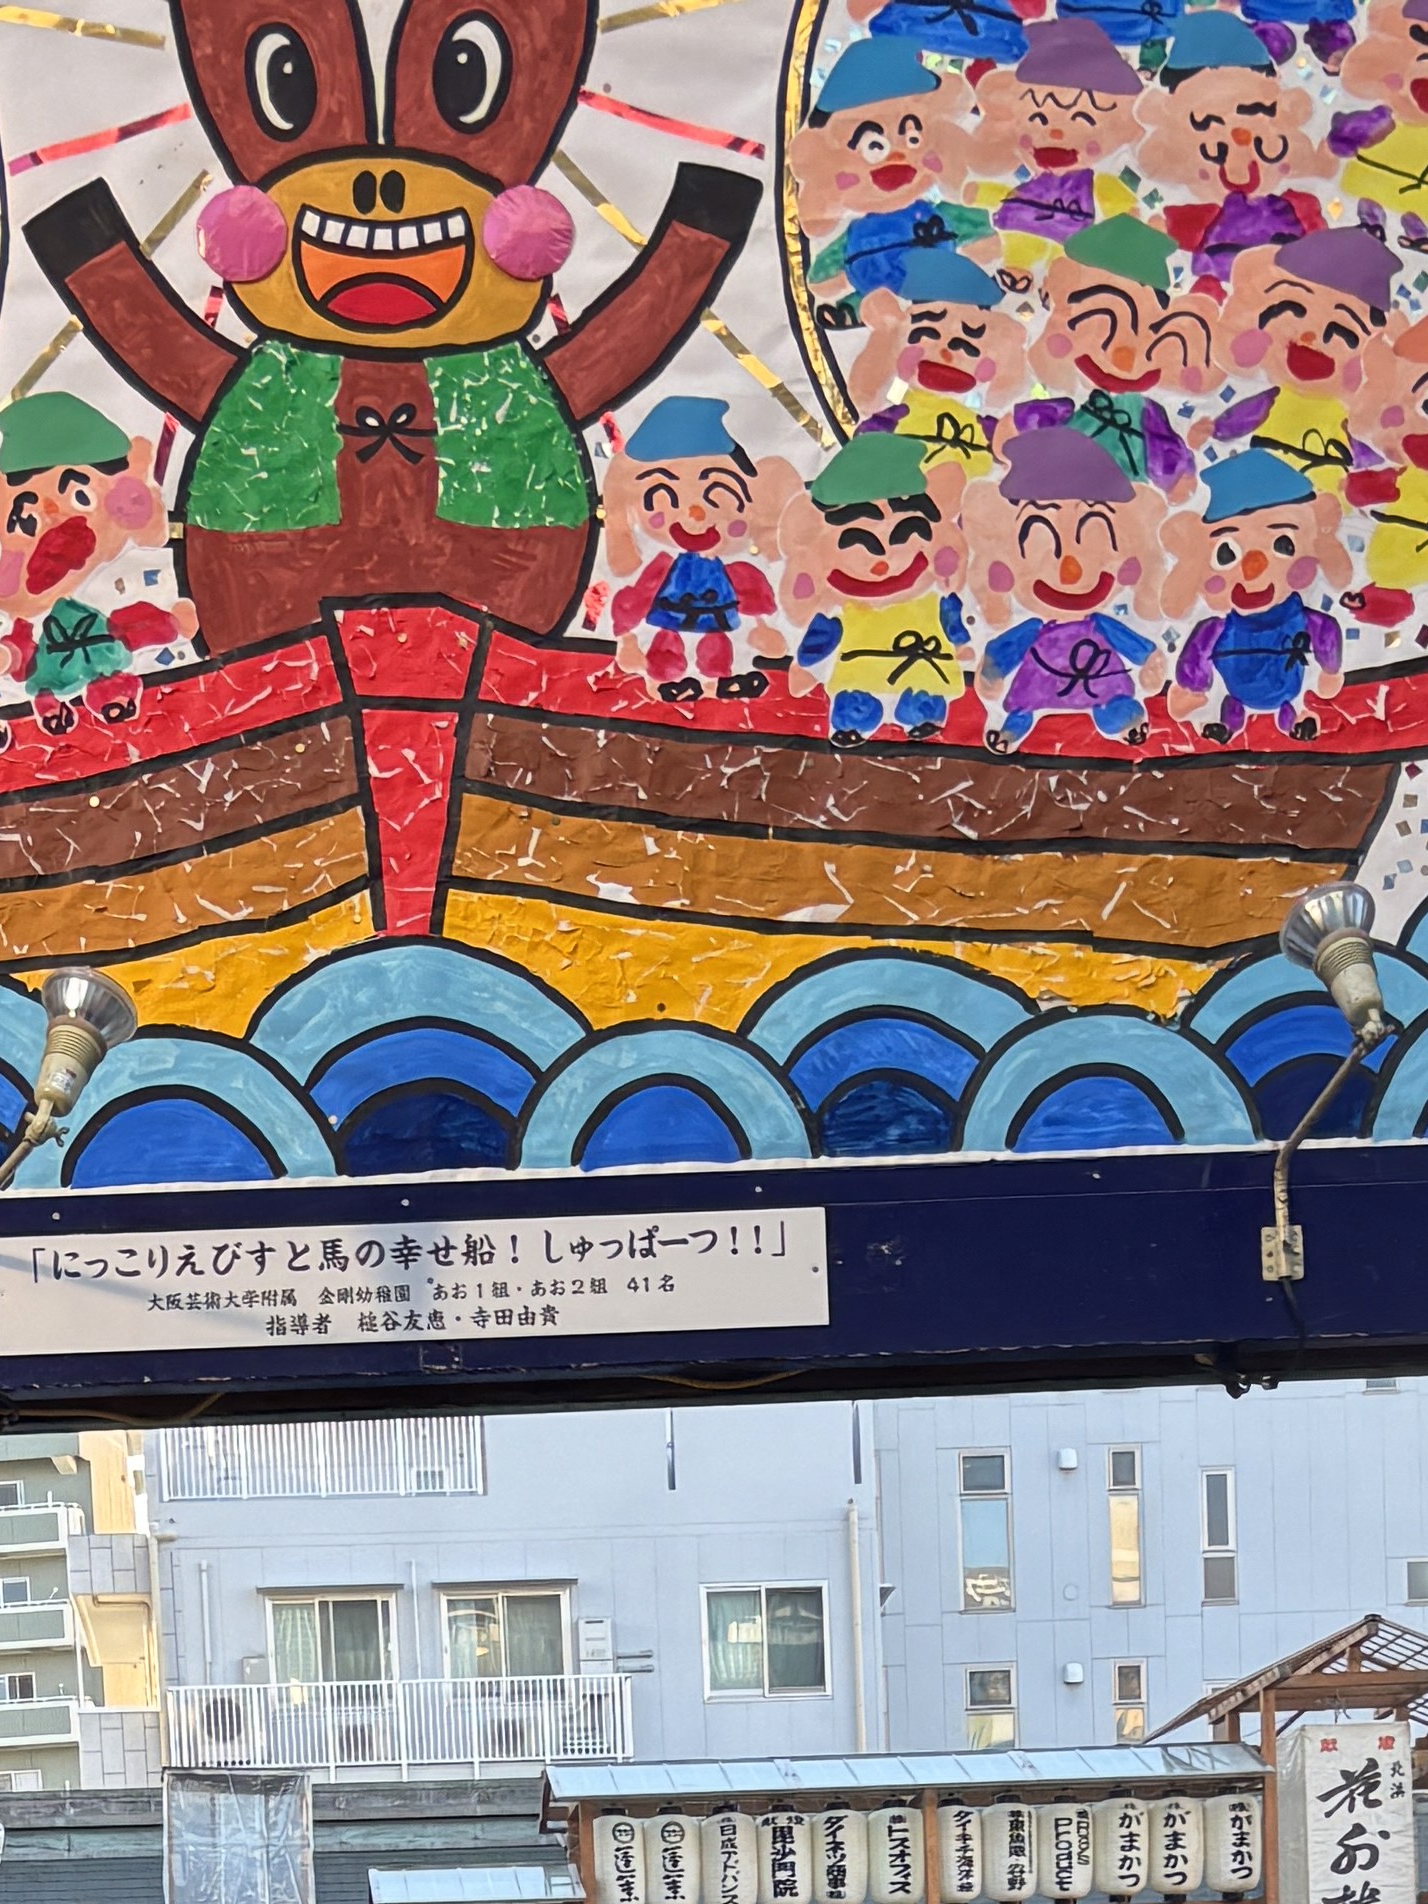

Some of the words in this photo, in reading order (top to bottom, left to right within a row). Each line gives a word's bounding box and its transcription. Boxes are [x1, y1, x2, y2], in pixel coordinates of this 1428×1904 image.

[147, 1288, 298, 1312] 大阪芸術大学附属
[318, 1284, 411, 1306] 金剛幼稚園
[627, 1273, 676, 1294] 41名
[266, 1312, 333, 1337] 指導者
